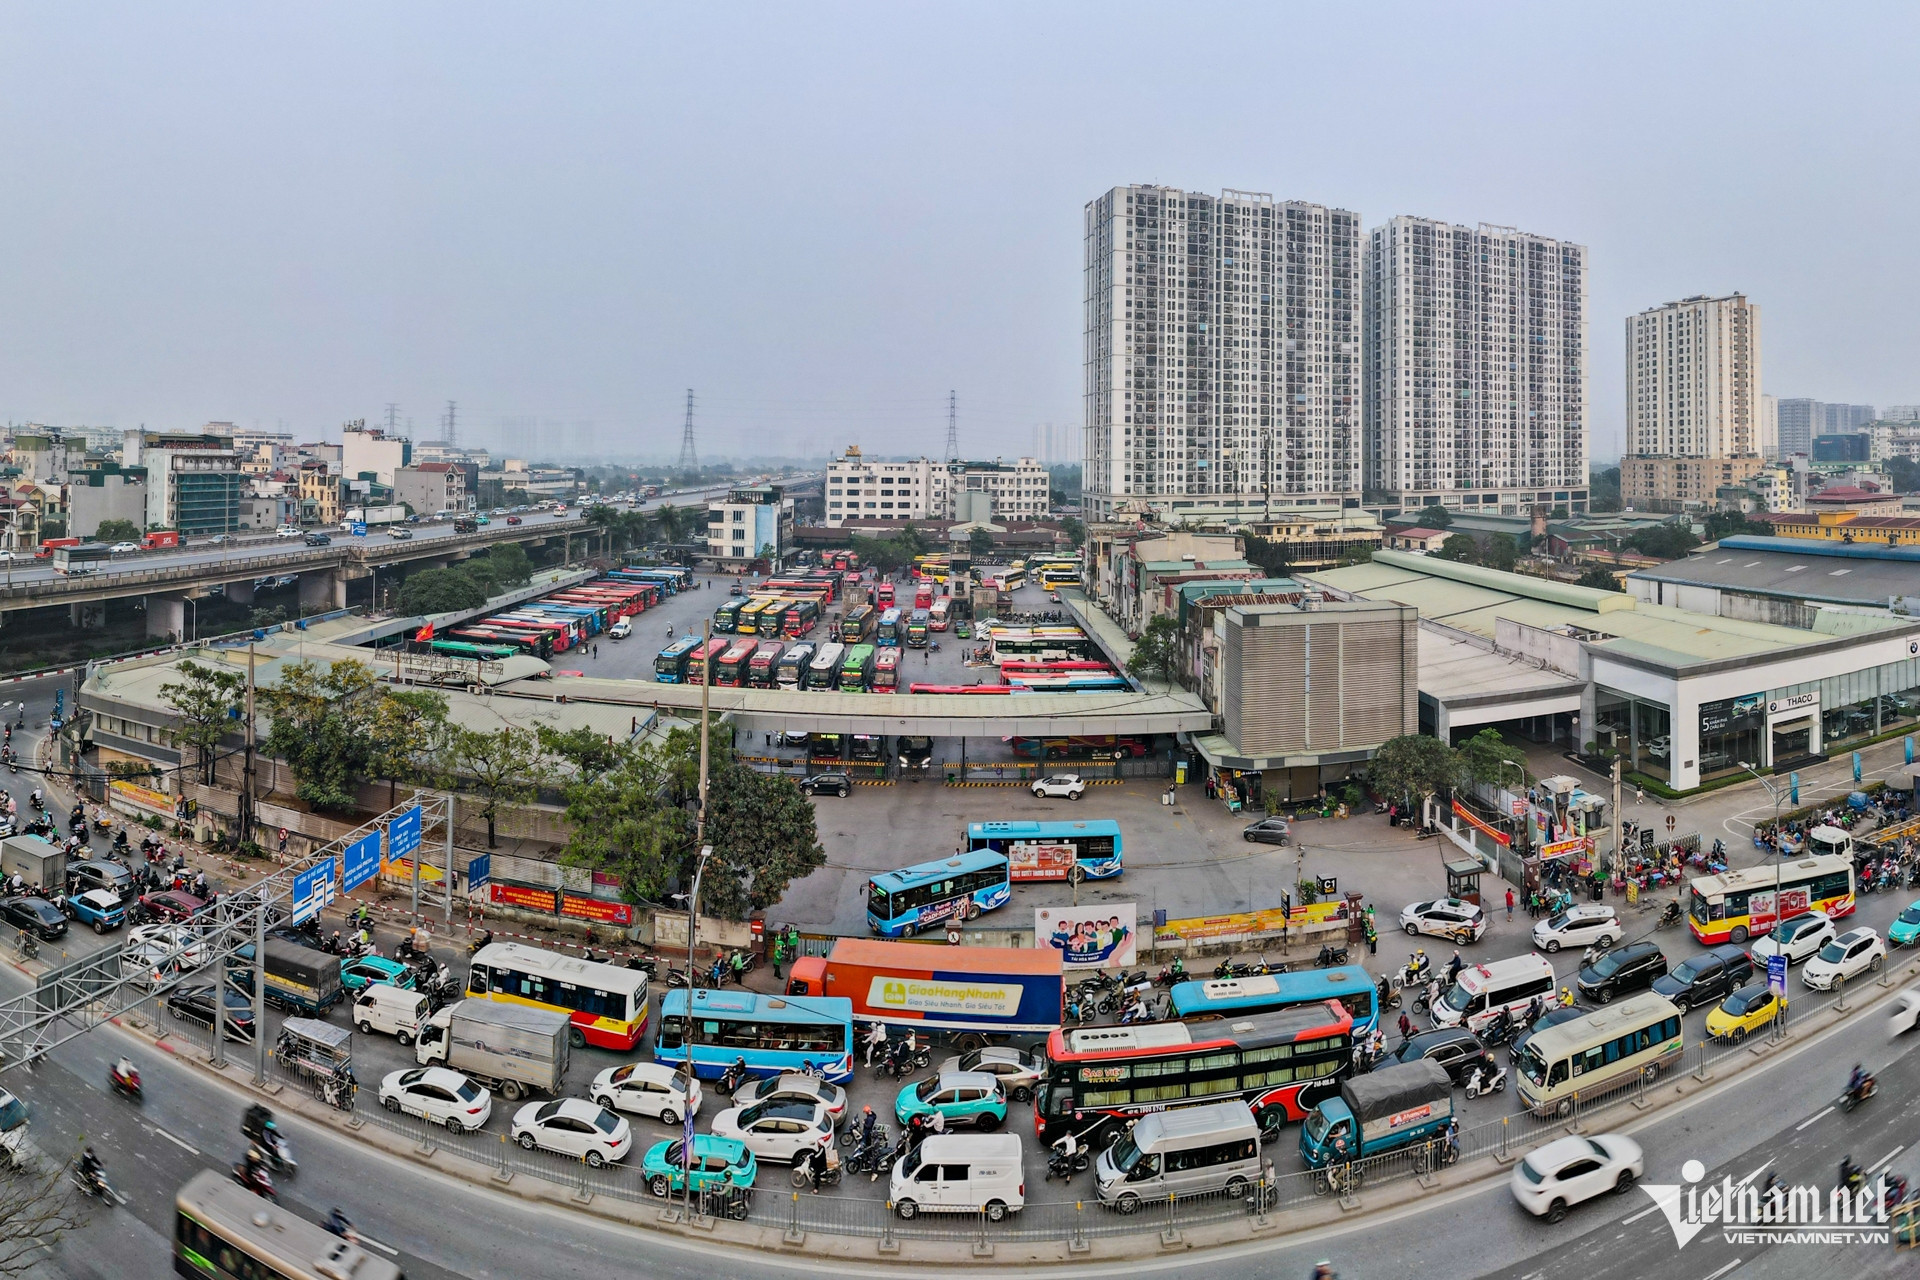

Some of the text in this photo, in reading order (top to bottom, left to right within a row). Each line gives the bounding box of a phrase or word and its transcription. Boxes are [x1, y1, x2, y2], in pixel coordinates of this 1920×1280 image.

[1787, 694, 1813, 706] THACO
[1702, 717, 1710, 732] 5
[1324, 880, 1335, 889] C1
[908, 983, 1006, 1001] GiaoHangNhanh
[908, 998, 923, 1006] Giao
[1082, 1067, 1104, 1078] SAO
